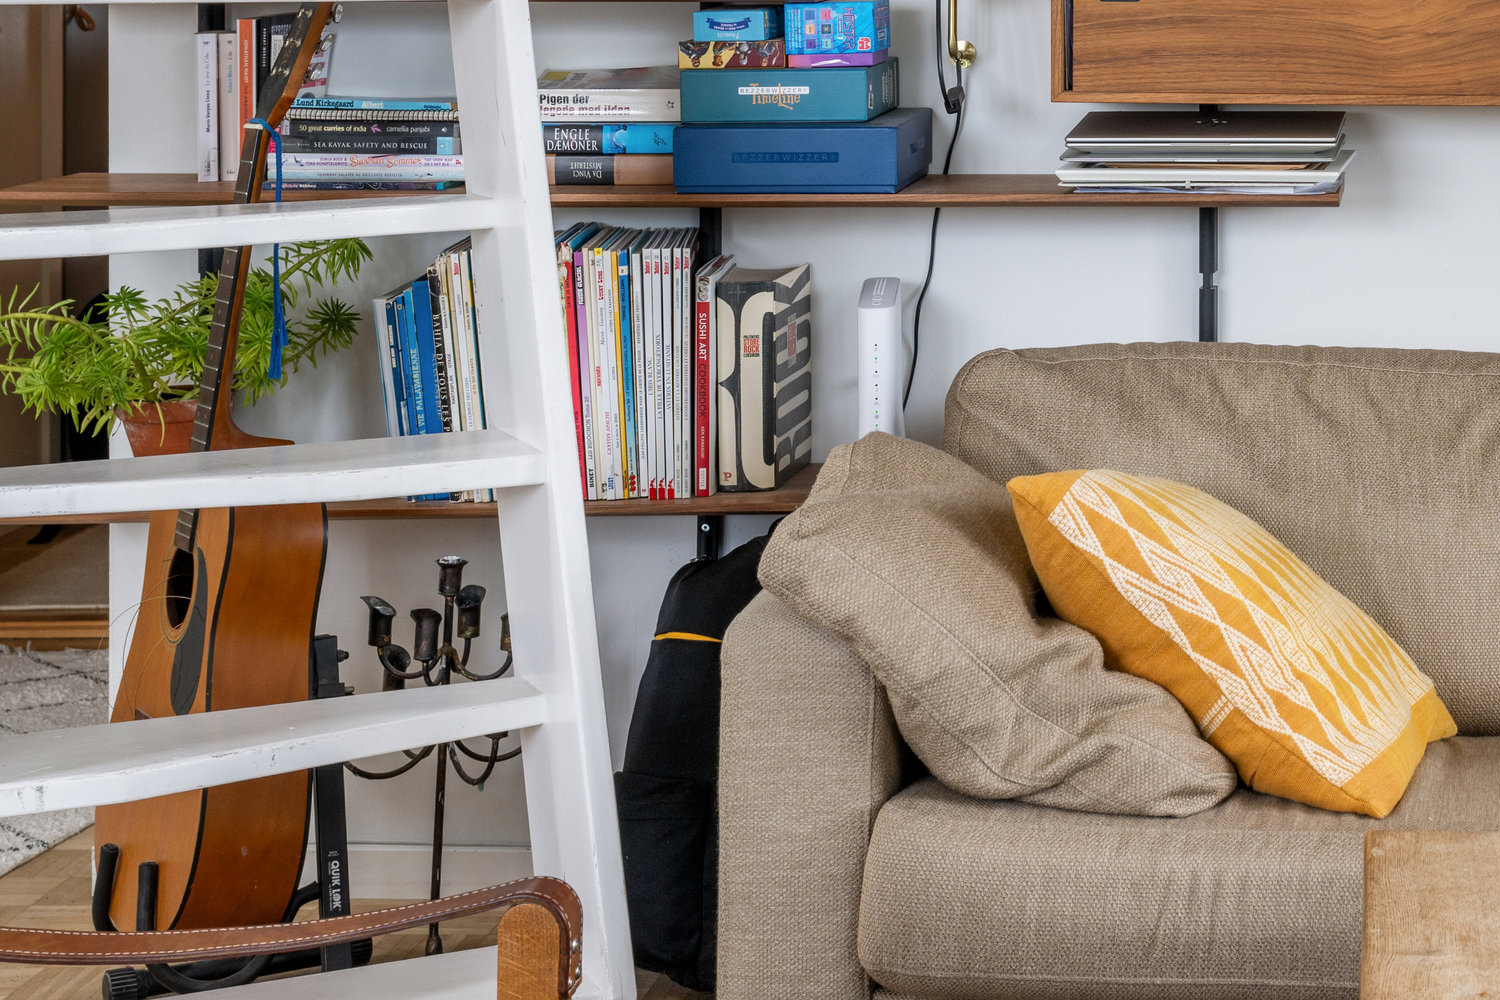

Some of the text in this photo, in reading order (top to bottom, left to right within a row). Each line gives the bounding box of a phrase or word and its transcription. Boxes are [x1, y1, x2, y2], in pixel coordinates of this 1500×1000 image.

[842, 7, 855, 50] HITSTER
[296, 99, 384, 109] Lund Kirkegaard Albert
[539, 94, 589, 107] Pigen der
[307, 125, 323, 133] great
[554, 127, 590, 141] ENGLE
[353, 141, 379, 149] SAFETY
[546, 140, 598, 151] DÆMONER
[699, 312, 707, 418] SUSHI ART COOKBOOK
[331, 860, 341, 887] QUIK
